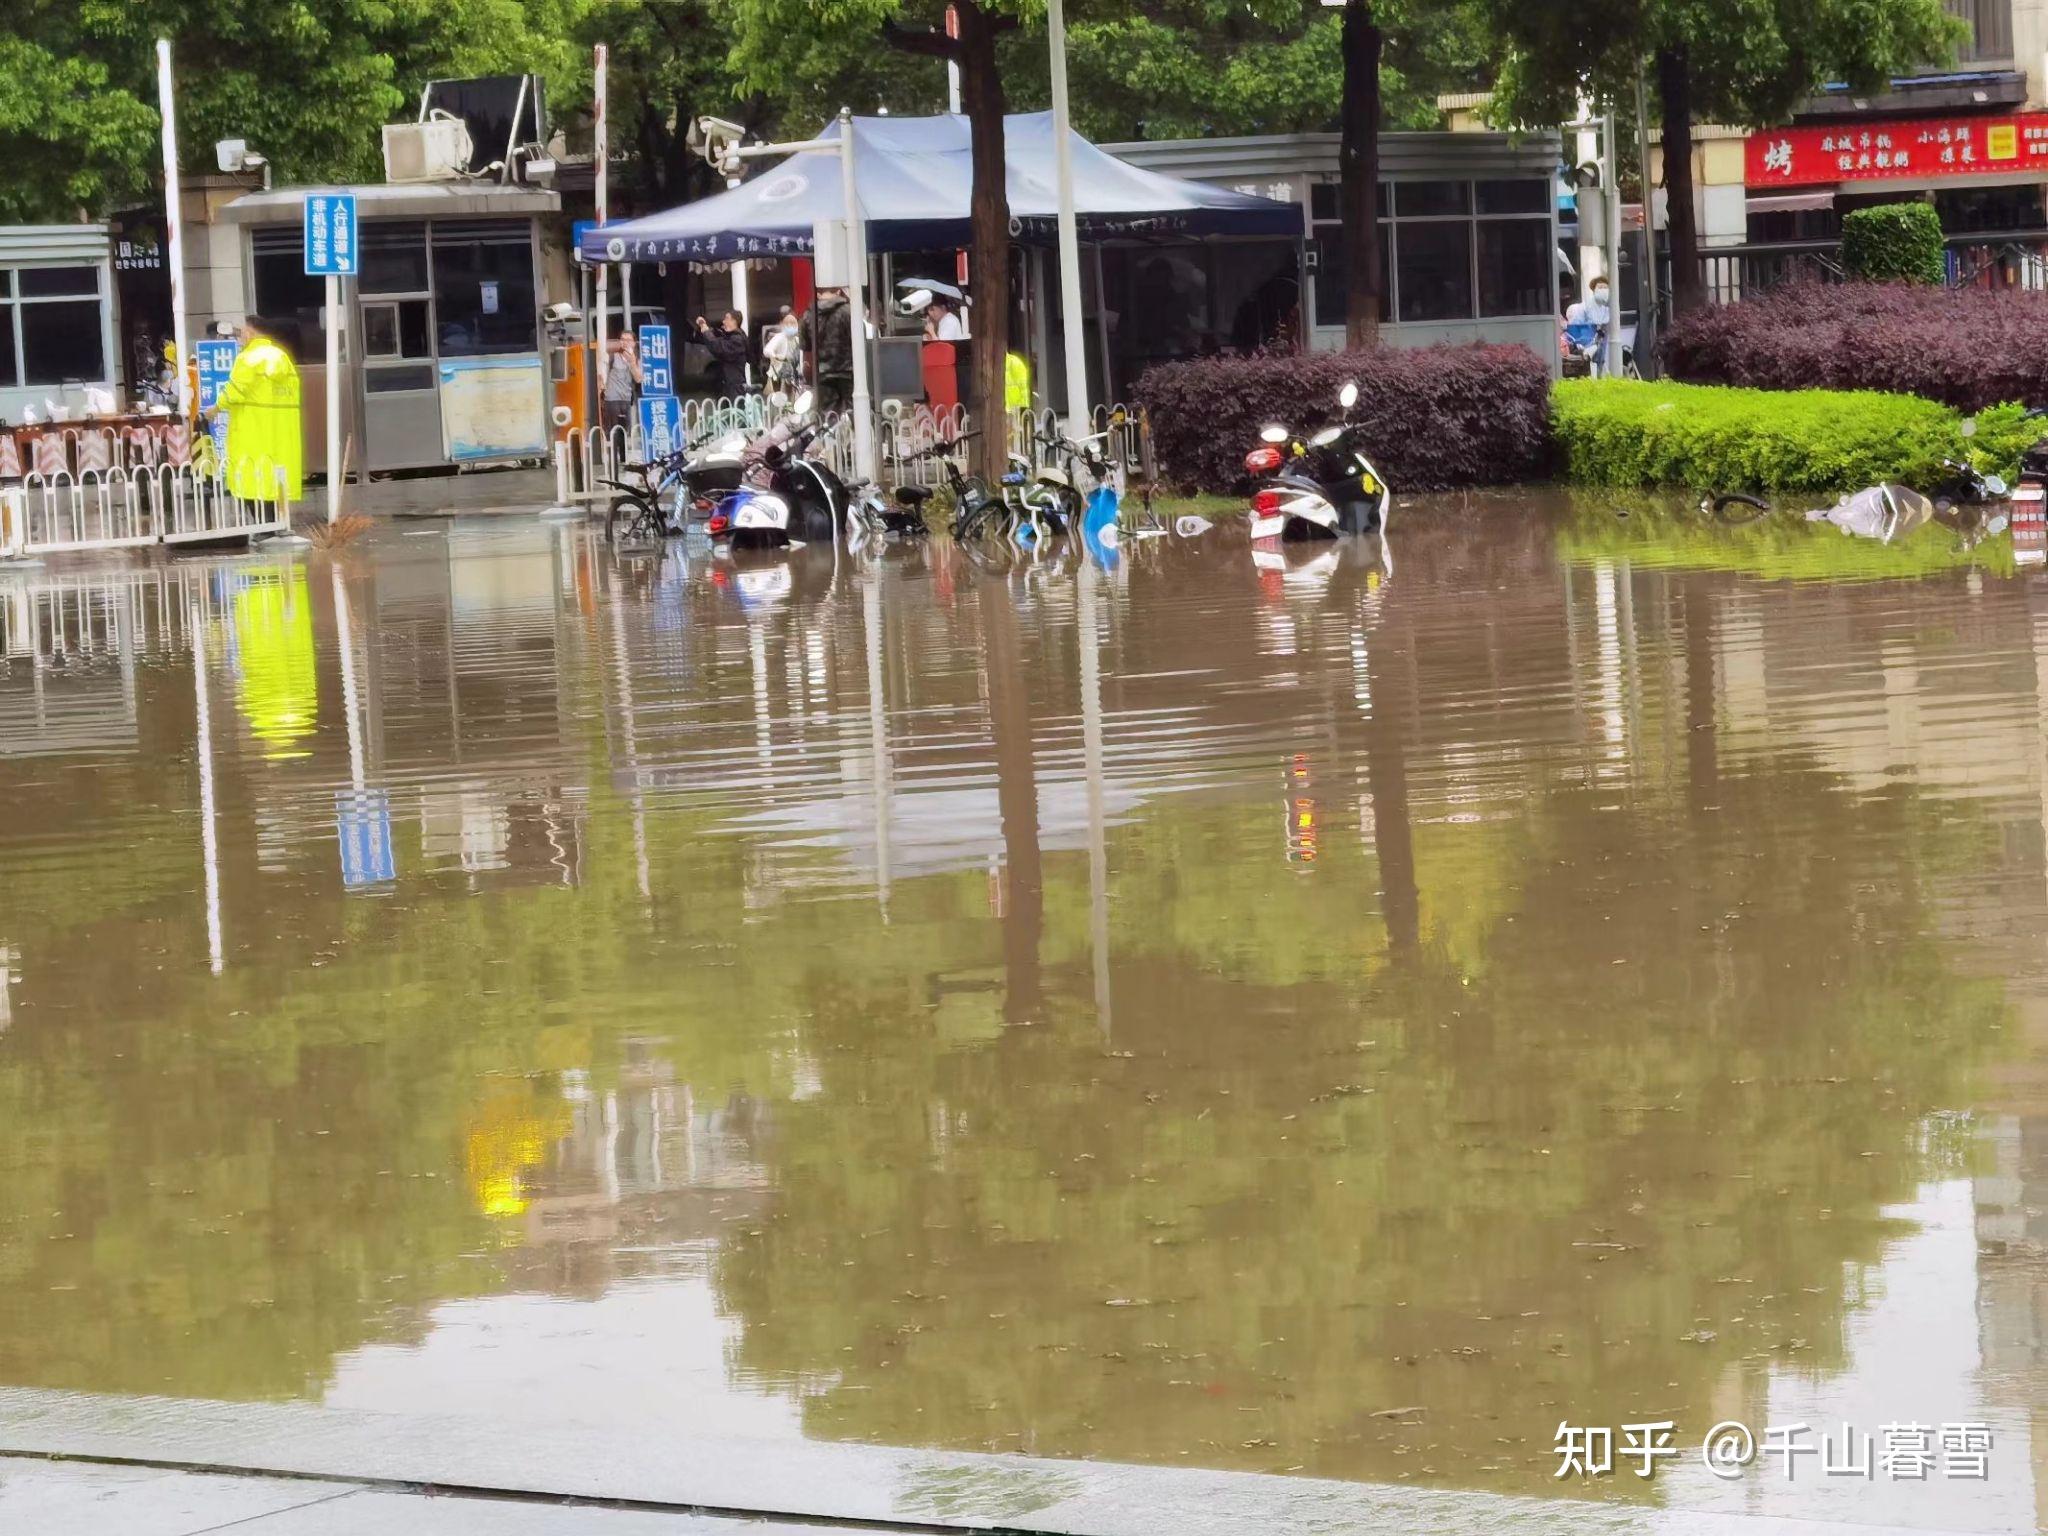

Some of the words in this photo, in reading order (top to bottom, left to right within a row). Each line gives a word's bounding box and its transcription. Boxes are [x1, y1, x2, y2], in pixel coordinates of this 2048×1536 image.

[1764, 139, 1793, 176] 烤
[311, 199, 327, 267] 非机动车道
[333, 199, 349, 254] 人行通道
[651, 333, 669, 390] 出口
